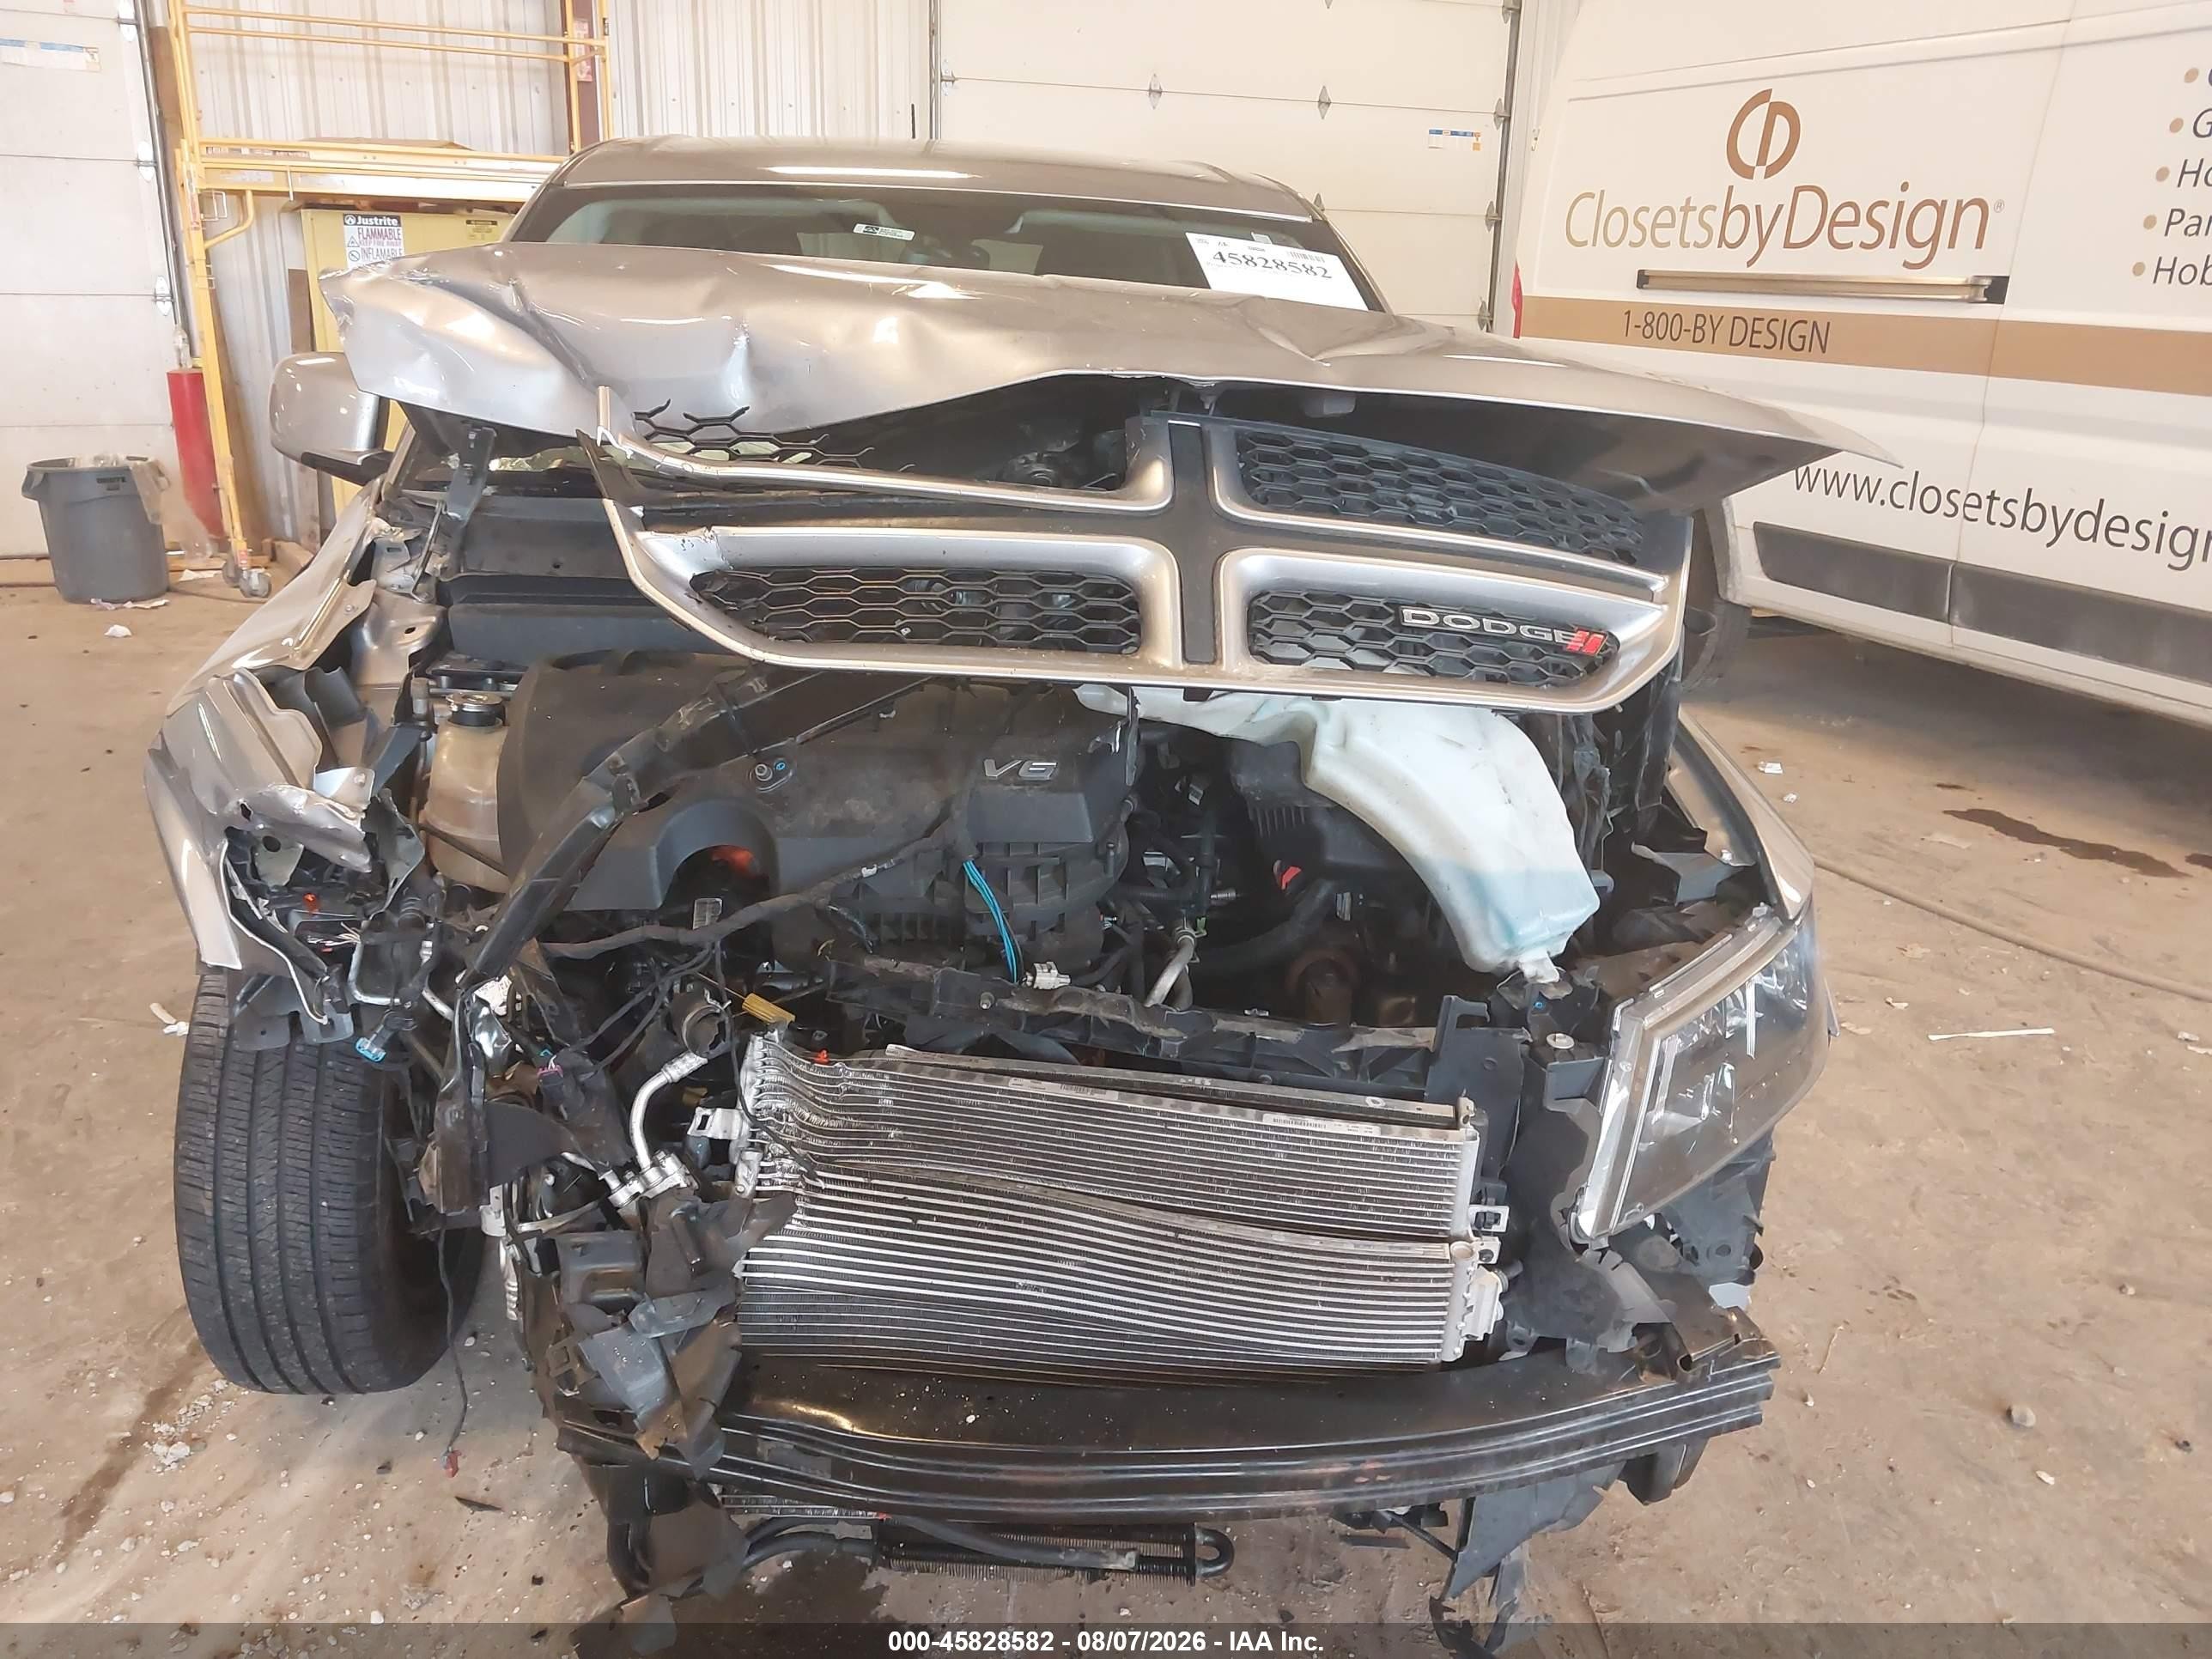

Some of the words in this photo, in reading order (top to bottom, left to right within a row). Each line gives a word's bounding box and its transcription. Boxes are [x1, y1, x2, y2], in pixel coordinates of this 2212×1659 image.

[356, 216, 398, 226] Justrite
[357, 228, 401, 240] FLAMMABLE
[1212, 251, 1333, 279] 45828582
[1623, 309, 1724, 344] 1-800-BY
[1729, 315, 1831, 354] DESIGN
[1402, 608, 1583, 646] DODGE
[983, 758, 1058, 781] V6
